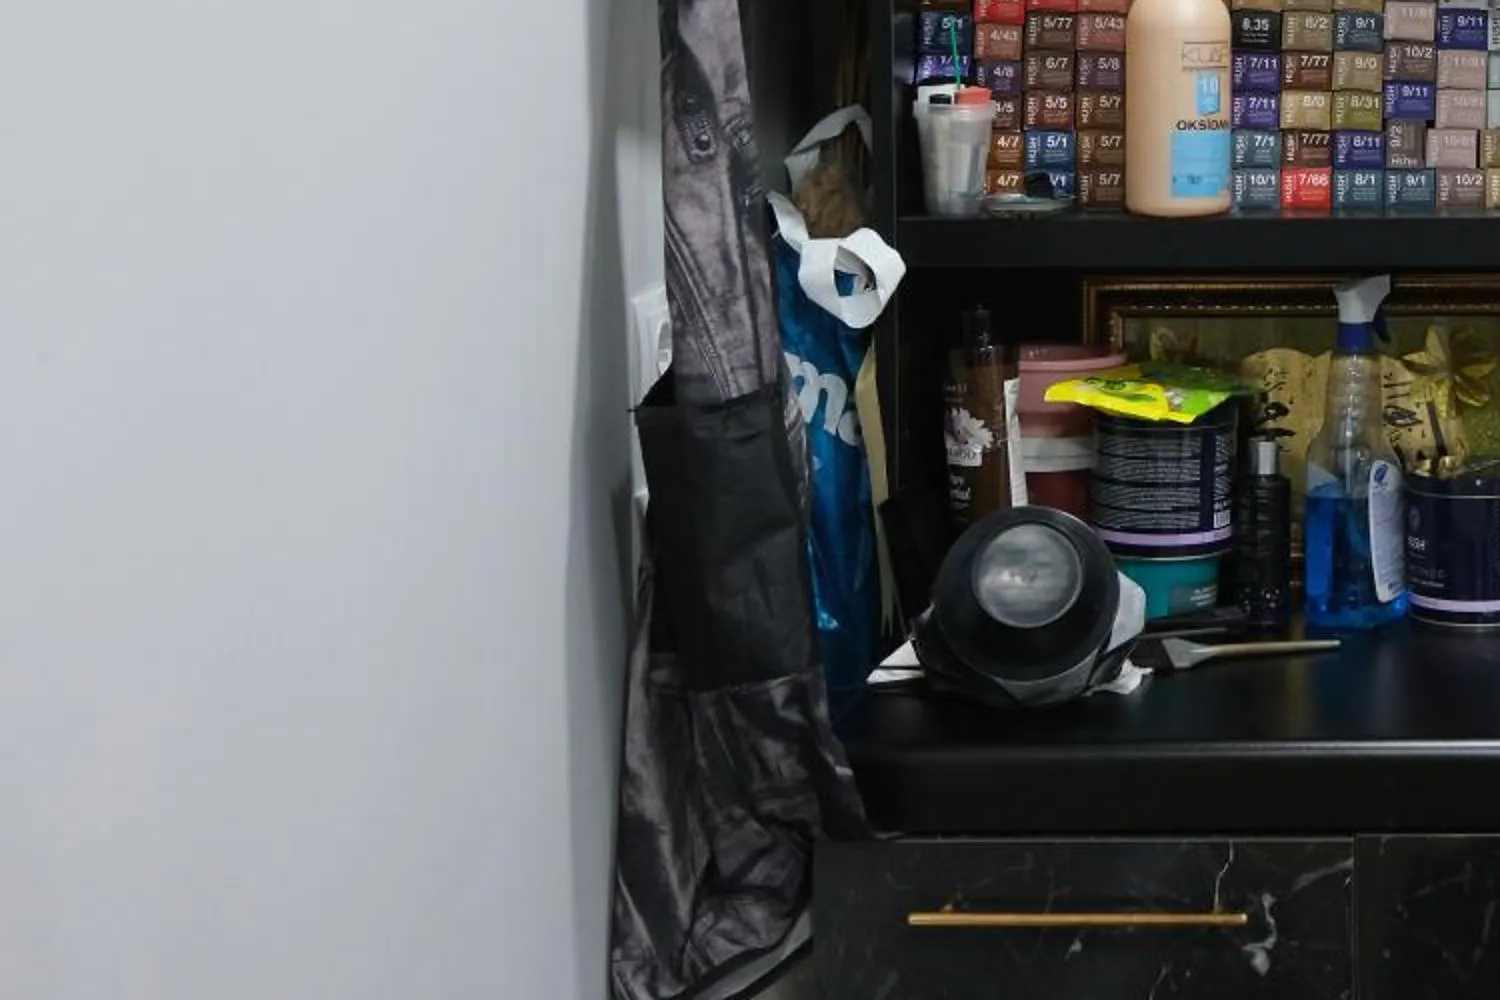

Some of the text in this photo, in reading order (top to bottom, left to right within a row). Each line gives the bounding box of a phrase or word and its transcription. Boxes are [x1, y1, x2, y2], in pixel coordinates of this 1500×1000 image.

[1250, 57, 1277, 69] 7/11
[1100, 96, 1121, 108] 5/7
[1248, 98, 1275, 110] 7/11
[997, 136, 1019, 148] 4/7
[1047, 136, 1067, 148] 5/1
[1102, 136, 1122, 148] 5/7
[1254, 136, 1275, 147] 7/1
[997, 175, 1019, 187] 4/7
[1100, 174, 1121, 185] 5/7
[1250, 174, 1276, 186] 10/1
[1455, 174, 1483, 186] 10/2
